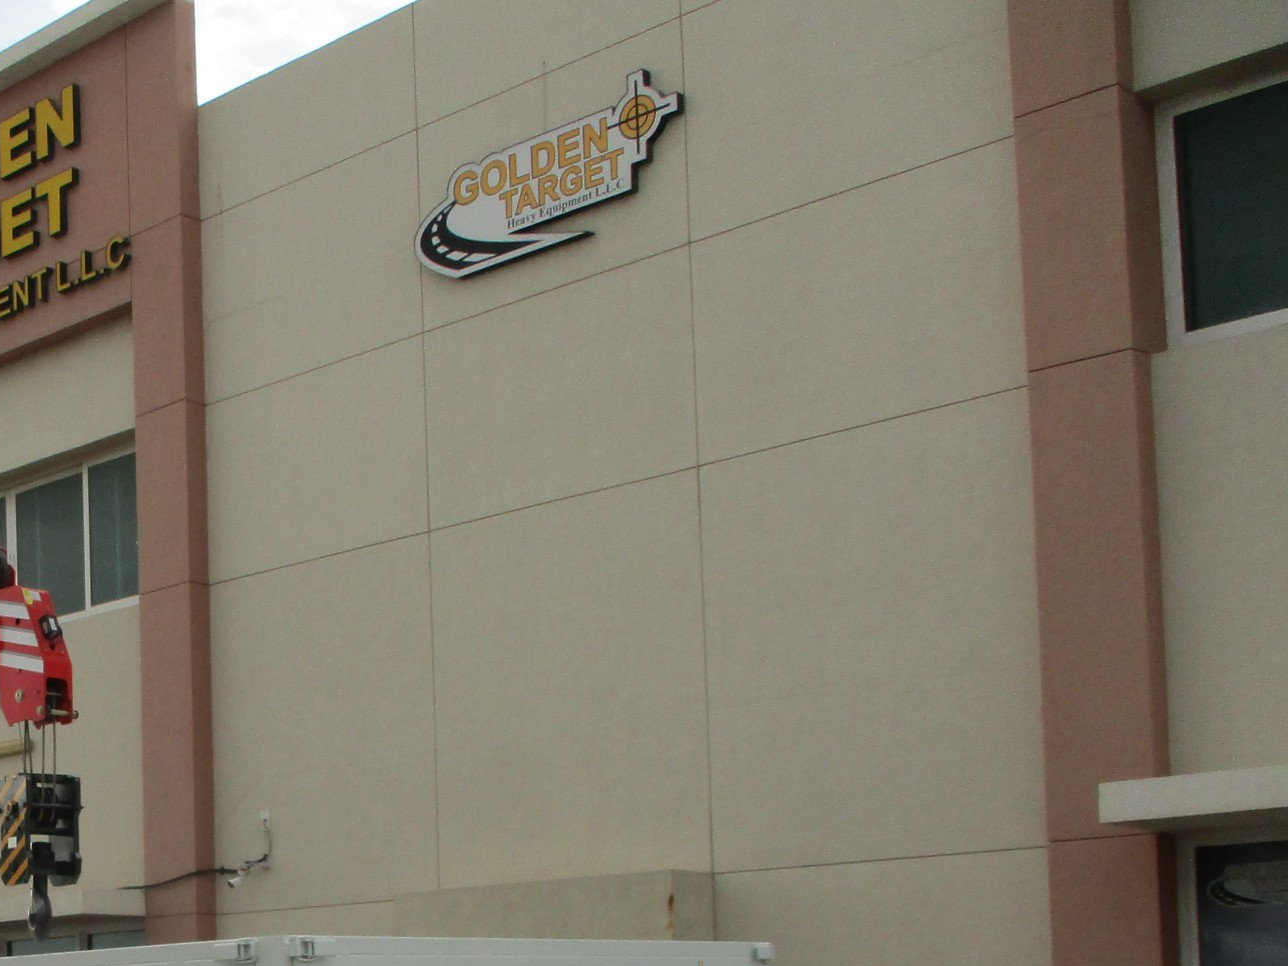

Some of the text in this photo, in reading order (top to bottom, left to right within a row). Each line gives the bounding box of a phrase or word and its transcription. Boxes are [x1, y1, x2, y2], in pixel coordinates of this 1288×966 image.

[452, 116, 609, 207] GOLDEN
[498, 147, 625, 220] TARGET
[507, 211, 536, 230] Heavy
[539, 192, 593, 217] Equipment
